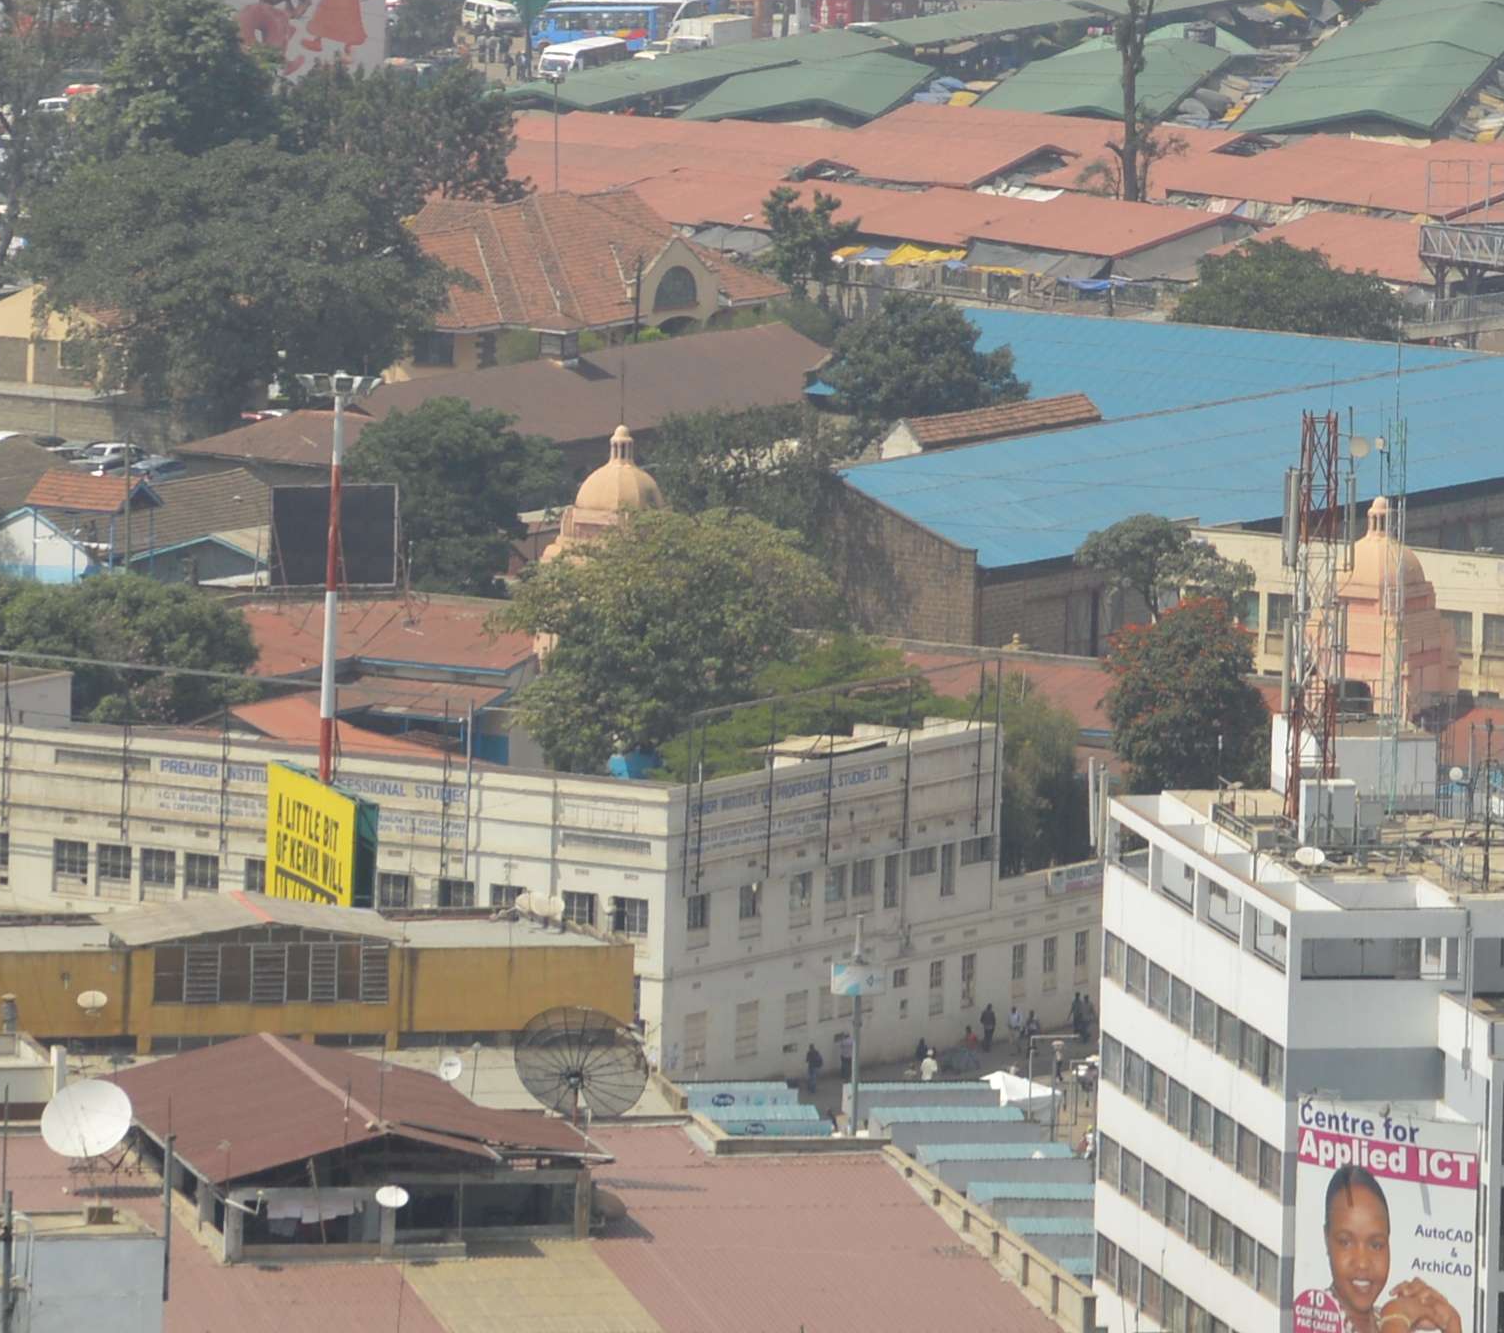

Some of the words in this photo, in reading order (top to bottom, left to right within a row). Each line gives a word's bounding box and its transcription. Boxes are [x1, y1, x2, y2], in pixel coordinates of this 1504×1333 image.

[160, 760, 219, 779] PREMIER
[277, 792, 283, 826] A
[286, 796, 320, 843] LITTLE
[322, 814, 340, 853] BIT
[276, 830, 288, 864] OF
[290, 835, 319, 881] KENYA
[322, 850, 343, 896] WILL
[1301, 1101, 1375, 1137] Centre
[1383, 1117, 1420, 1143] for
[1299, 1129, 1407, 1174] Applied
[1418, 1148, 1476, 1182] ICT
[1414, 1224, 1473, 1244] AutoCAD
[1450, 1247, 1458, 1258] &
[1411, 1257, 1473, 1278] ArchiCAD
[1307, 1290, 1325, 1307] 10
[1295, 1304, 1340, 1322] COMPUTER
